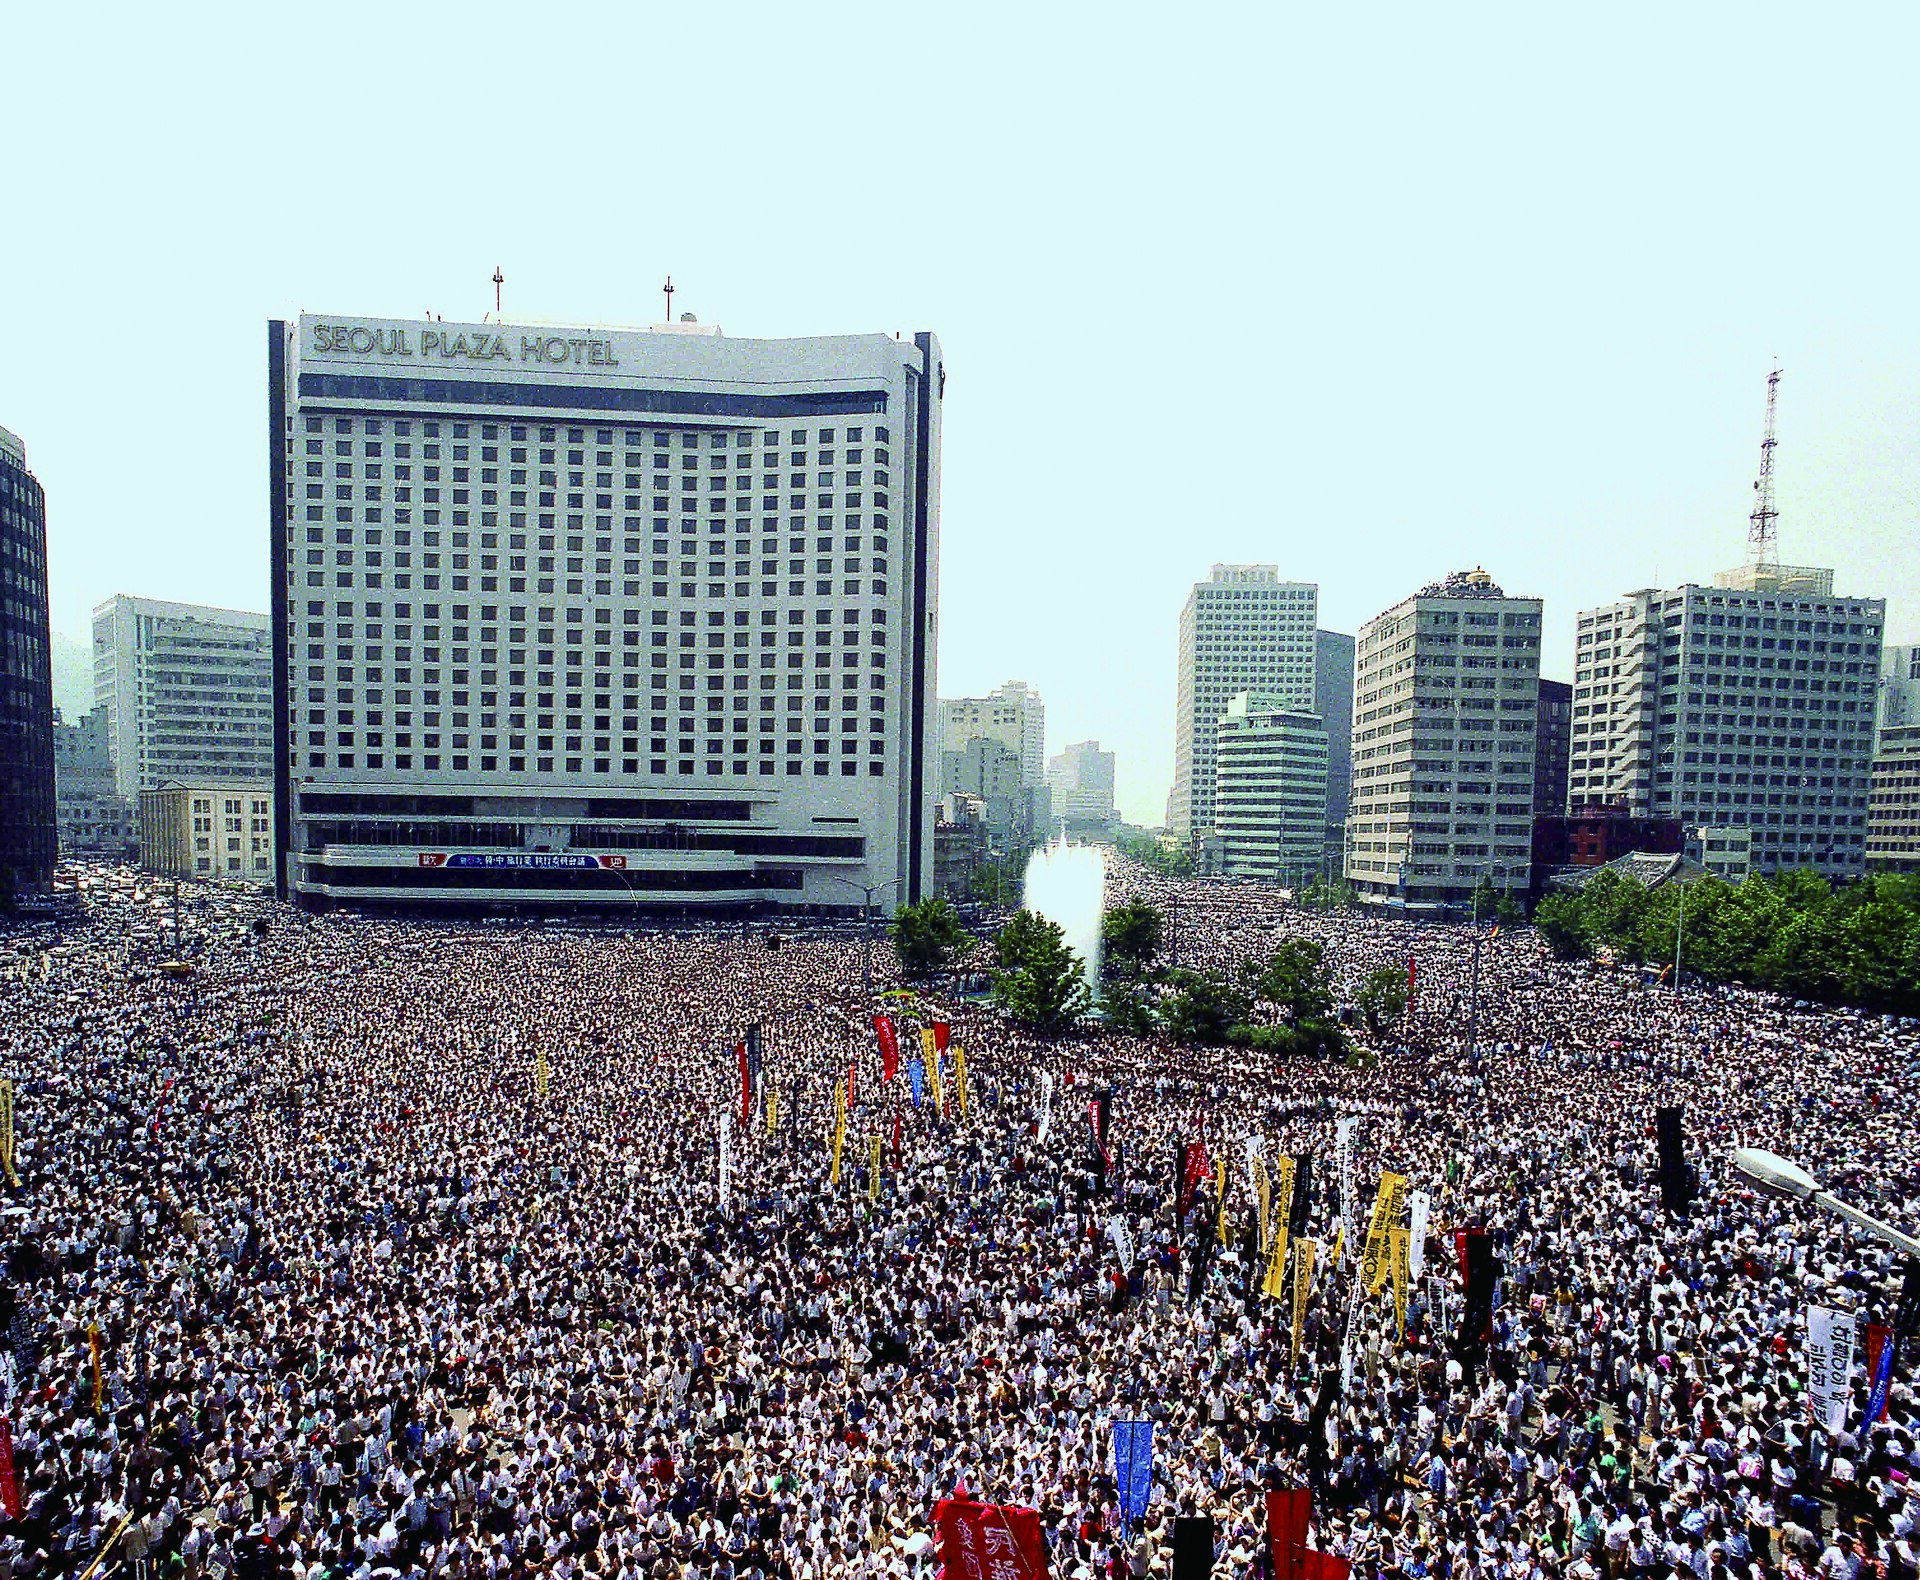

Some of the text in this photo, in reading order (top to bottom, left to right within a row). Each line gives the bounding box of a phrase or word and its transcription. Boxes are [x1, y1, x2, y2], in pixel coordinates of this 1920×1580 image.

[313, 324, 619, 365] SEOUL PLAZA HOTEL
